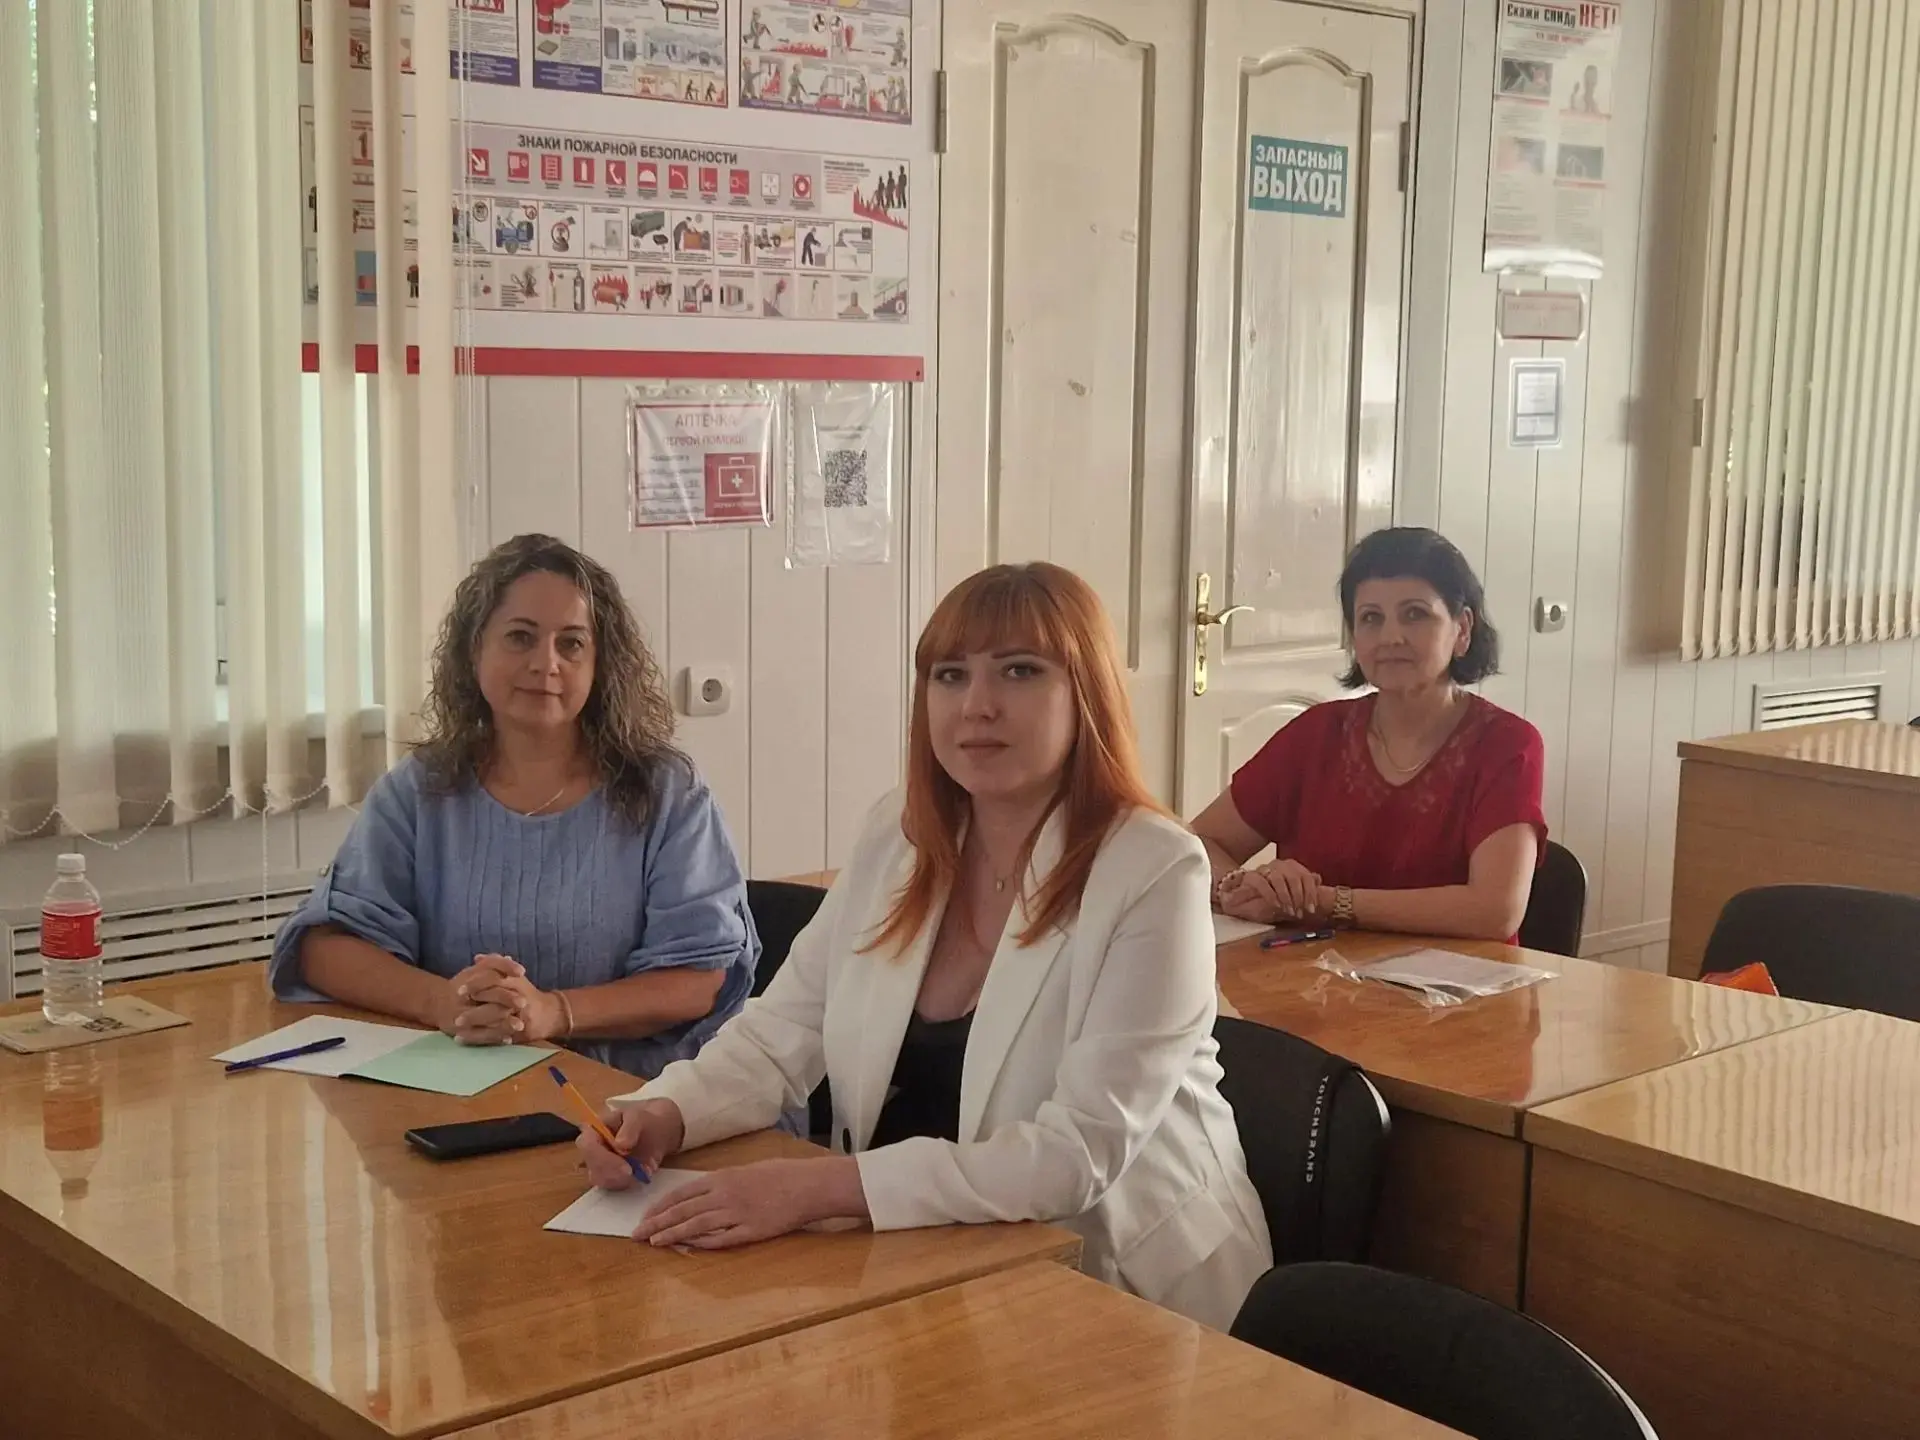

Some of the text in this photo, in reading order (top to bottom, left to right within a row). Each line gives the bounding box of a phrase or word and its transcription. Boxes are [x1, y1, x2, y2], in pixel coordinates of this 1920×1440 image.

[1507, 3, 1540, 21] Скажи
[1579, 3, 1616, 30] НЕТ!
[518, 134, 738, 165] ЗНАКИ ПОЖАРНОЙ БЕЗОПАСНОСТИ
[1255, 143, 1343, 171] ЗАПАСНЫЙ
[1253, 165, 1343, 212] ВЫХОД
[674, 412, 737, 428] АПТЕЧКА
